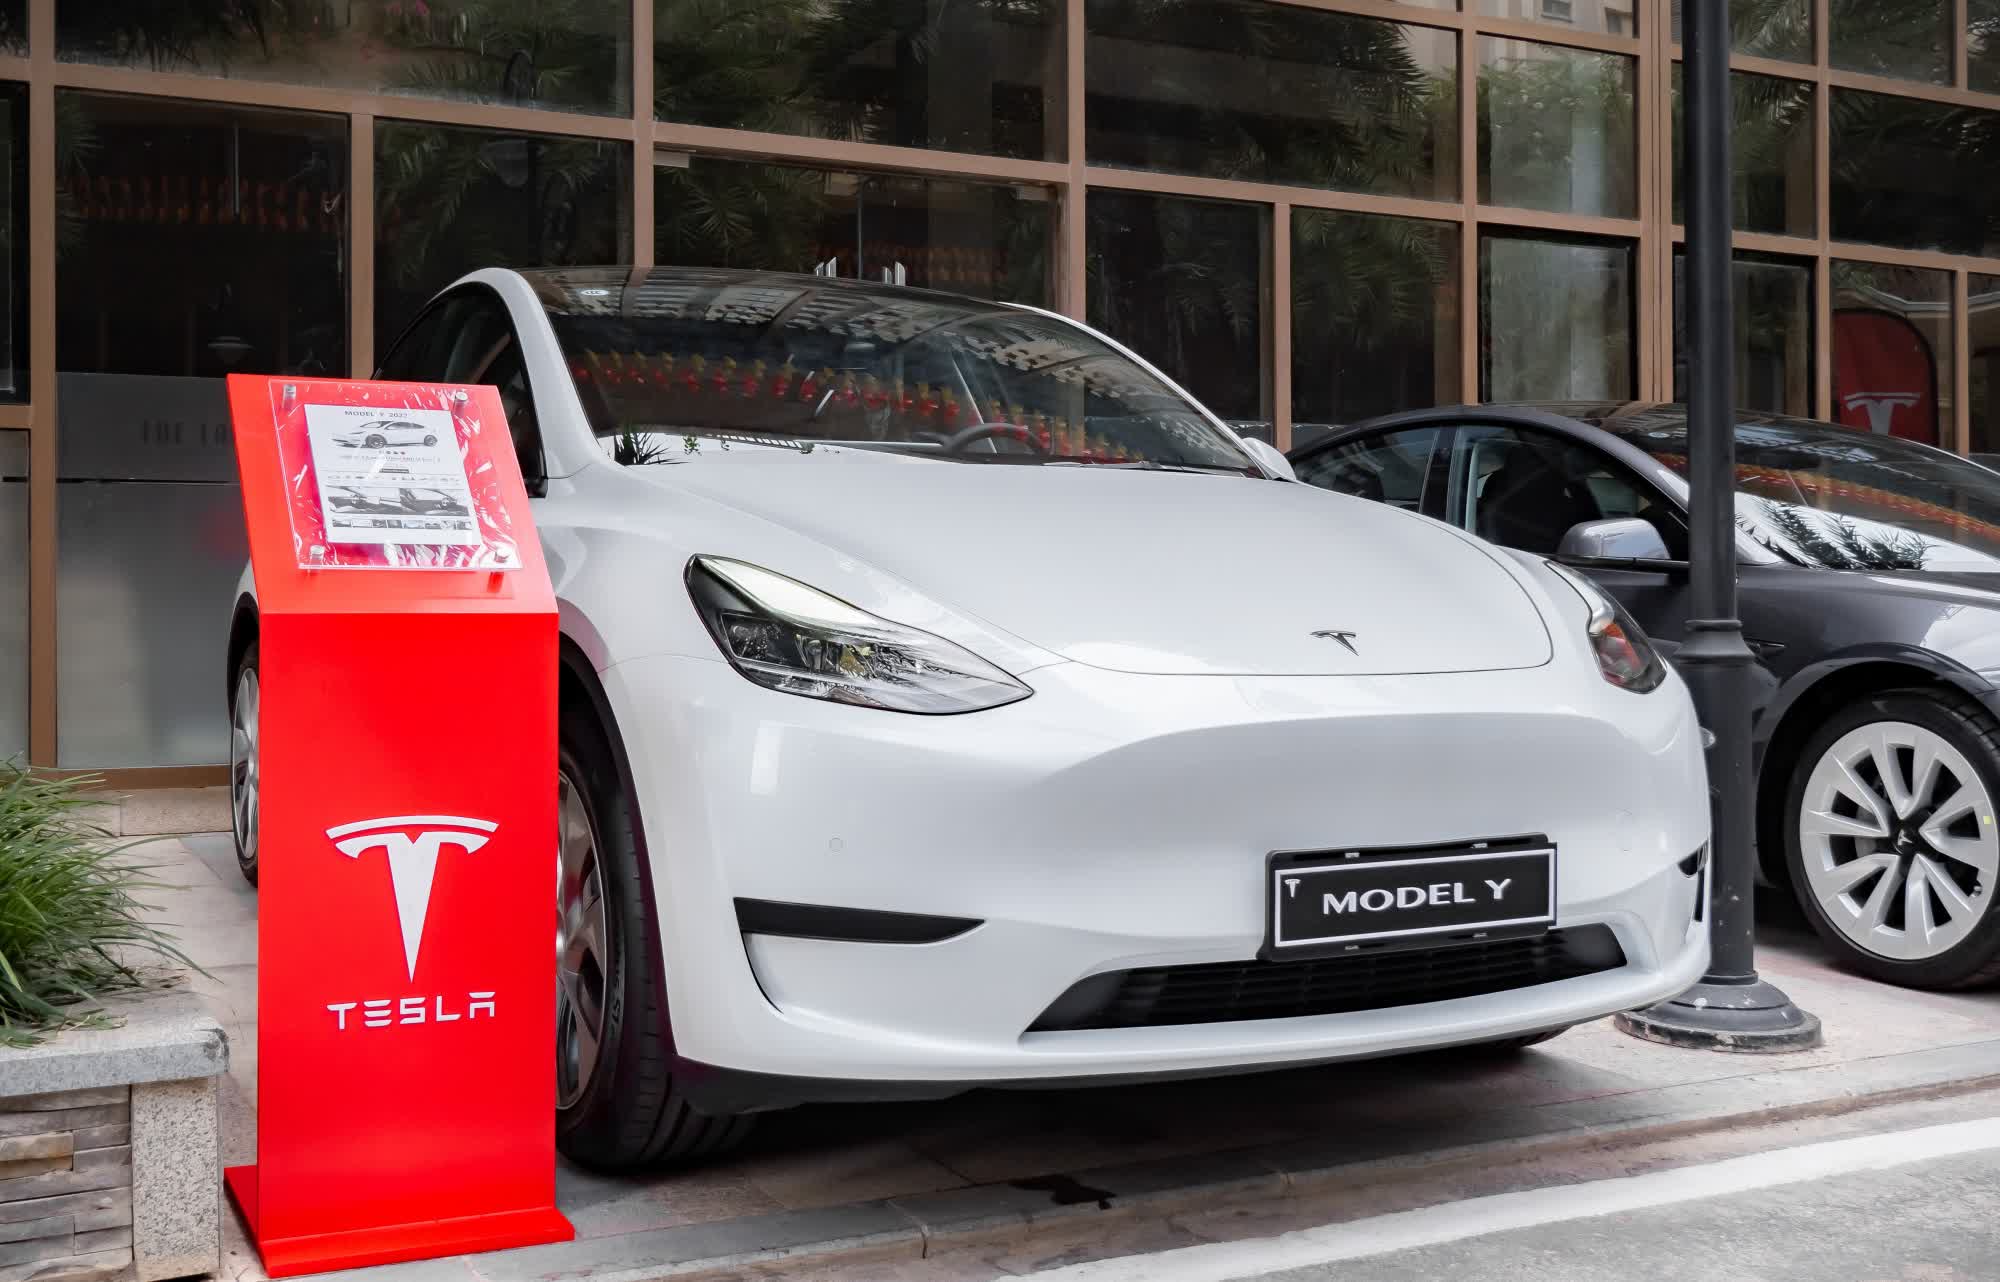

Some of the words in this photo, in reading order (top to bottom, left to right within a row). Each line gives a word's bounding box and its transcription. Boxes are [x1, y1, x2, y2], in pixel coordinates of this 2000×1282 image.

[1323, 882, 1476, 915] MODEL
[1484, 878, 1512, 900] Y
[326, 991, 496, 1030] TESLA
